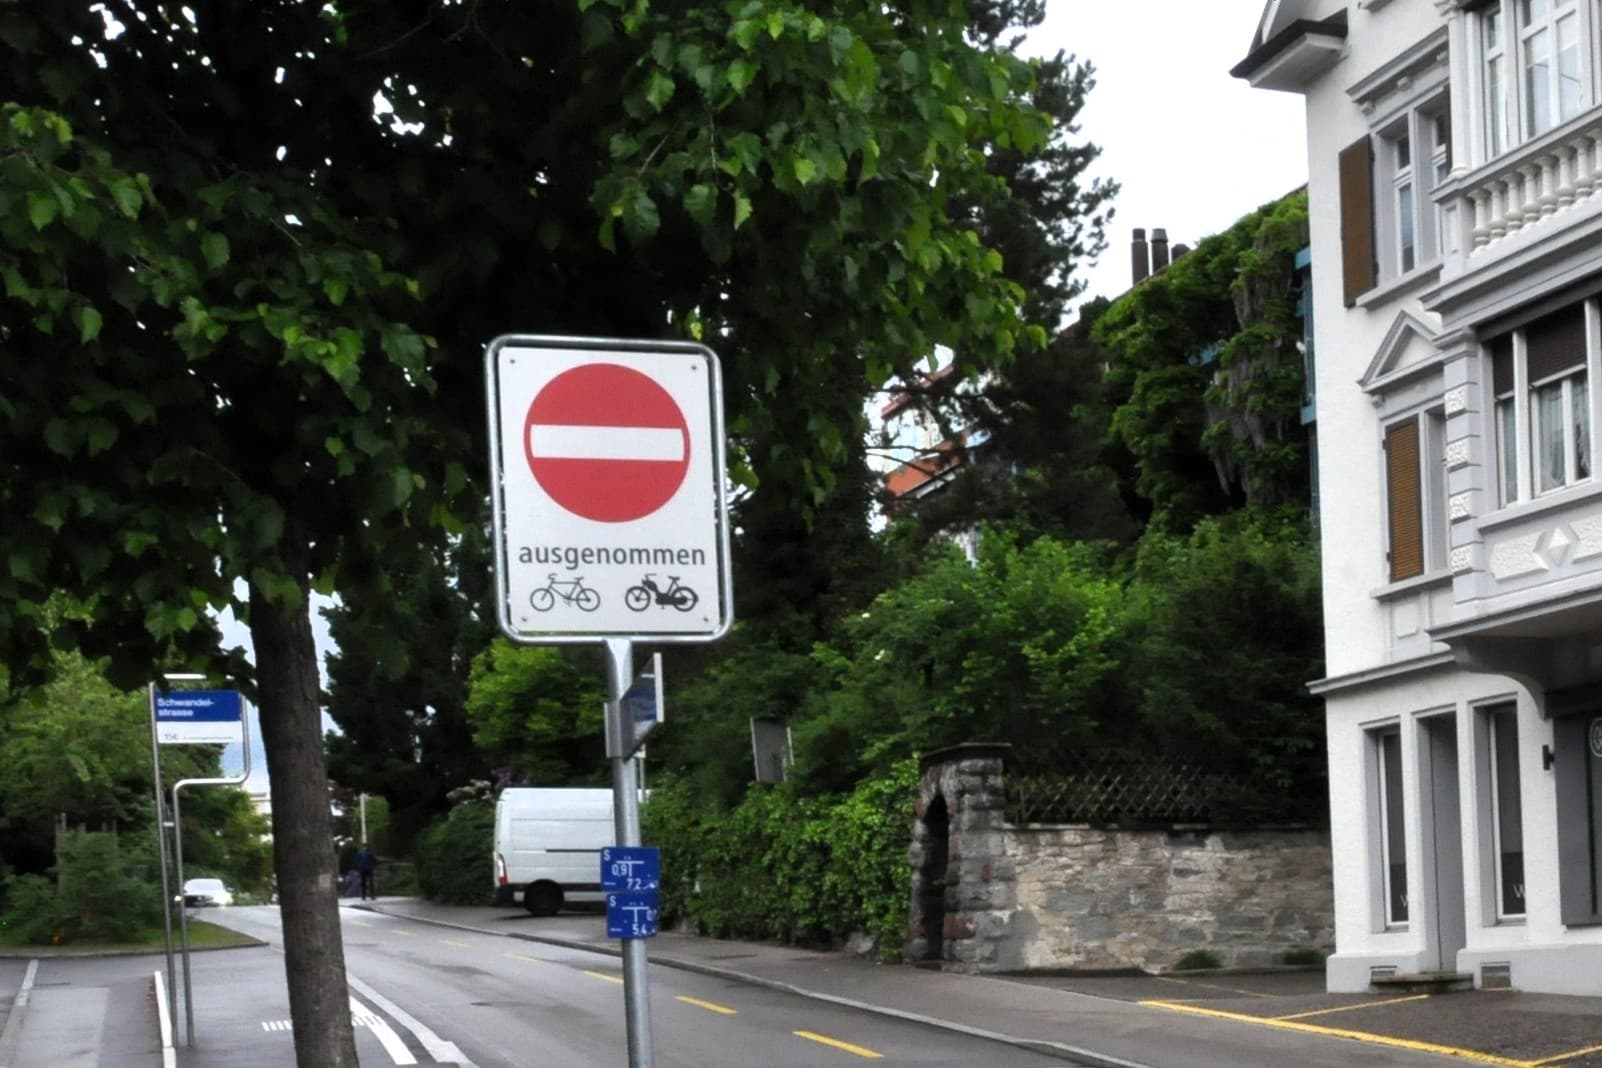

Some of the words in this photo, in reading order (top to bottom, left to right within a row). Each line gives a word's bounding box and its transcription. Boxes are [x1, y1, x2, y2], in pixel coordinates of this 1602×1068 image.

[519, 545, 706, 570] ausgenommen
[603, 849, 611, 861] S
[609, 895, 617, 907] S
